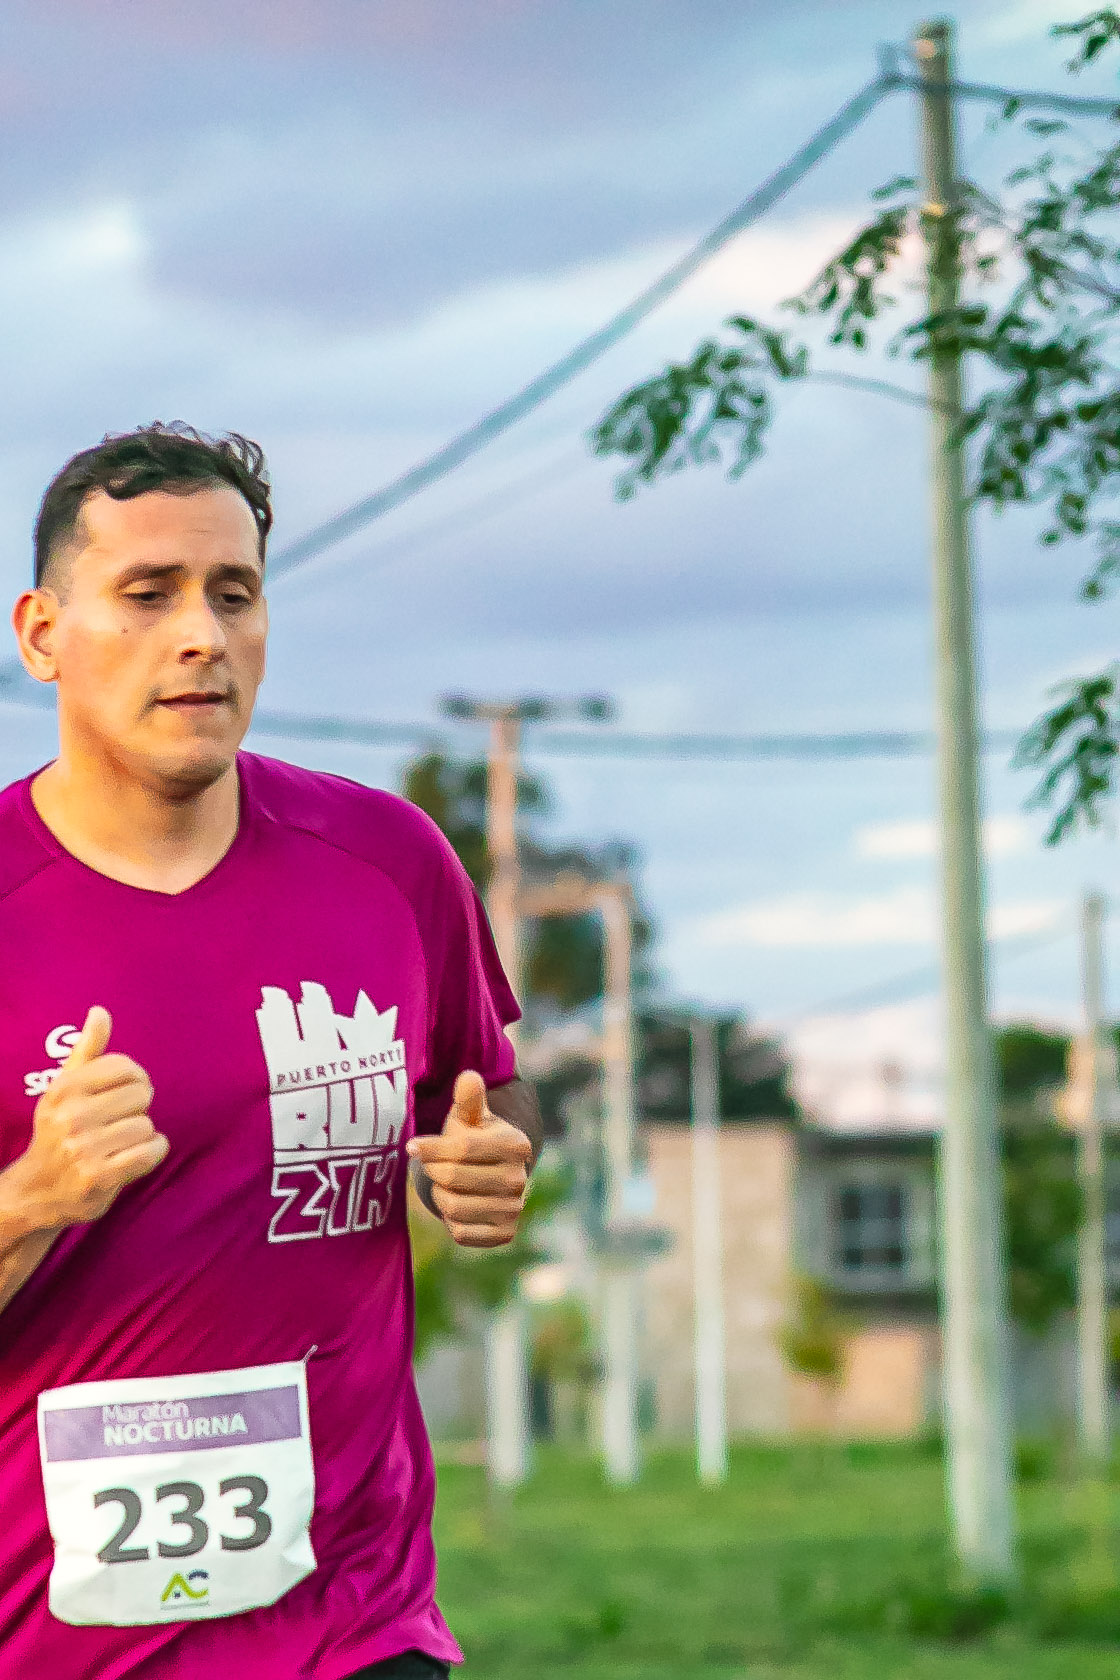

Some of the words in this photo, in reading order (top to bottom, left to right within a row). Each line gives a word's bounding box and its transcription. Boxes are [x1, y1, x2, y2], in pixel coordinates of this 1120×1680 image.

[276, 1059, 352, 1087] PUERTO
[270, 1066, 407, 1150] RUN
[104, 1412, 248, 1446] NOCTURNA
[93, 1473, 272, 1564] 233
